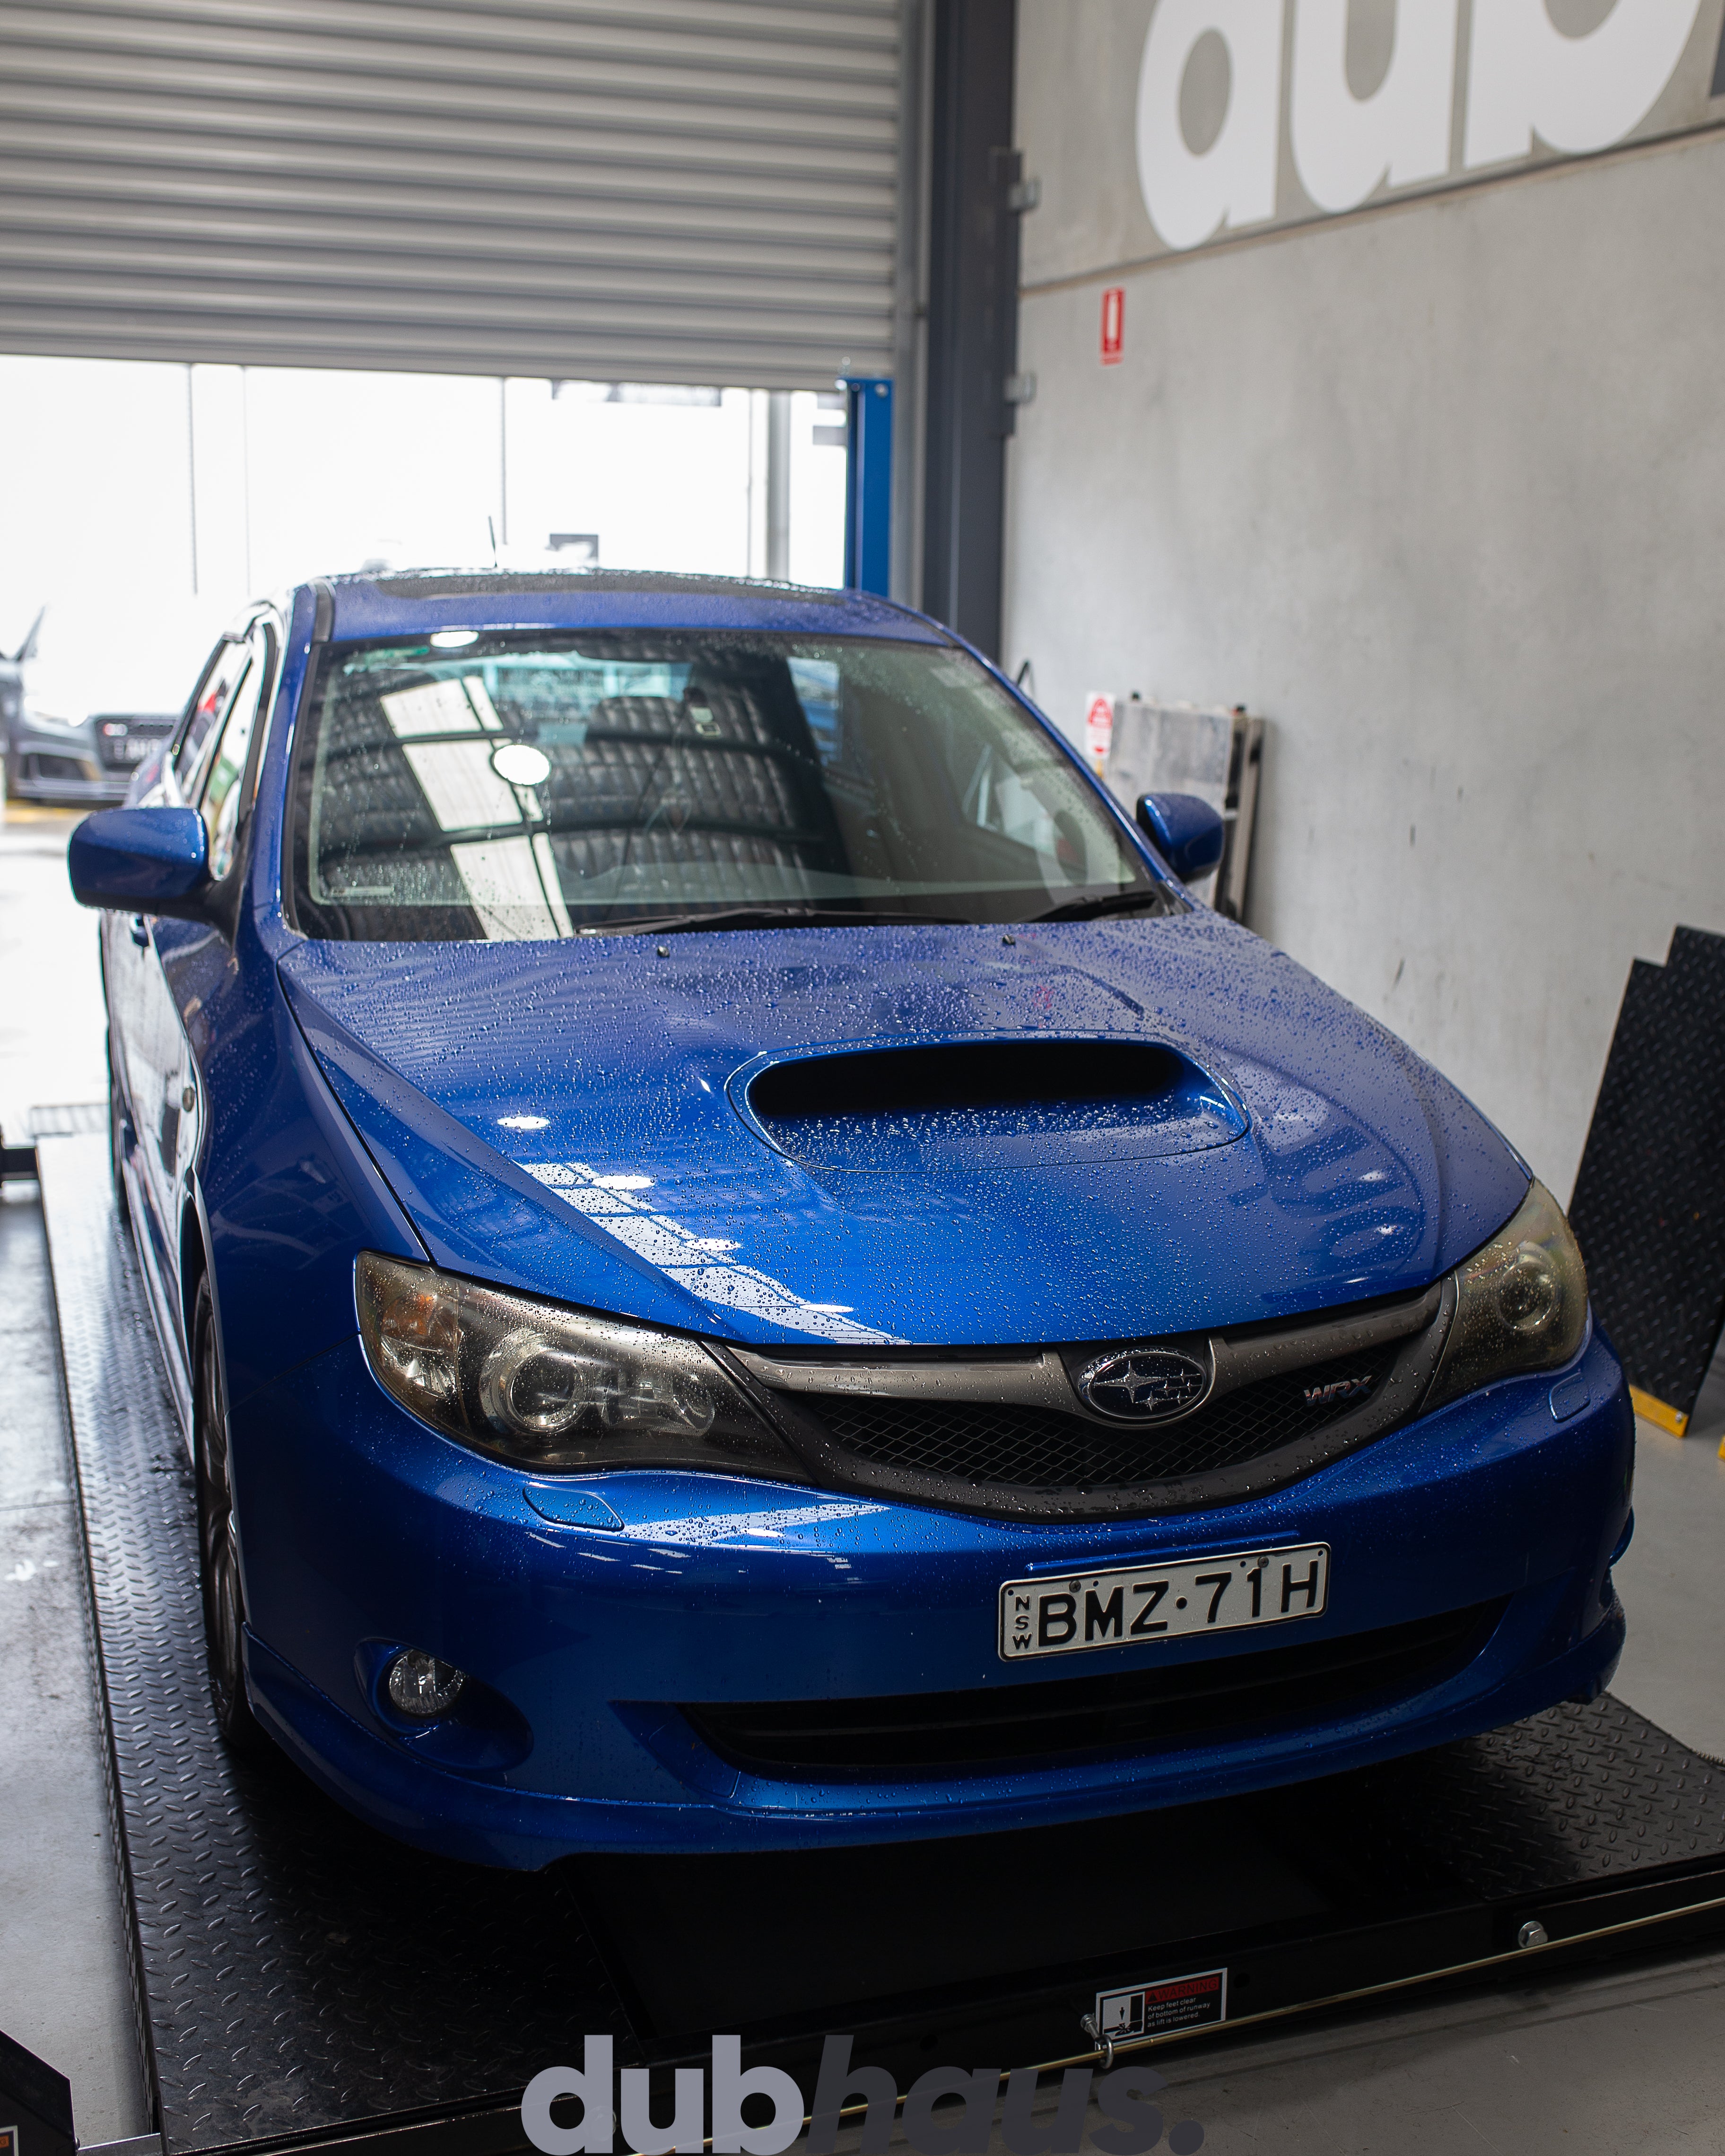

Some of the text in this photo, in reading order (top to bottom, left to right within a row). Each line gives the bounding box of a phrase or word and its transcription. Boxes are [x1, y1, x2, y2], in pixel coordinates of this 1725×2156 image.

[1304, 1375, 1372, 1406] WRX
[1014, 1595, 1033, 1650] NSW
[1159, 1979, 1217, 2000] WARNING
[1148, 2004, 1165, 2012] Keep
[1156, 2008, 1178, 2018] bottom
[1187, 2002, 1211, 2011] runway
[1173, 2012, 1200, 2022] lowered.
